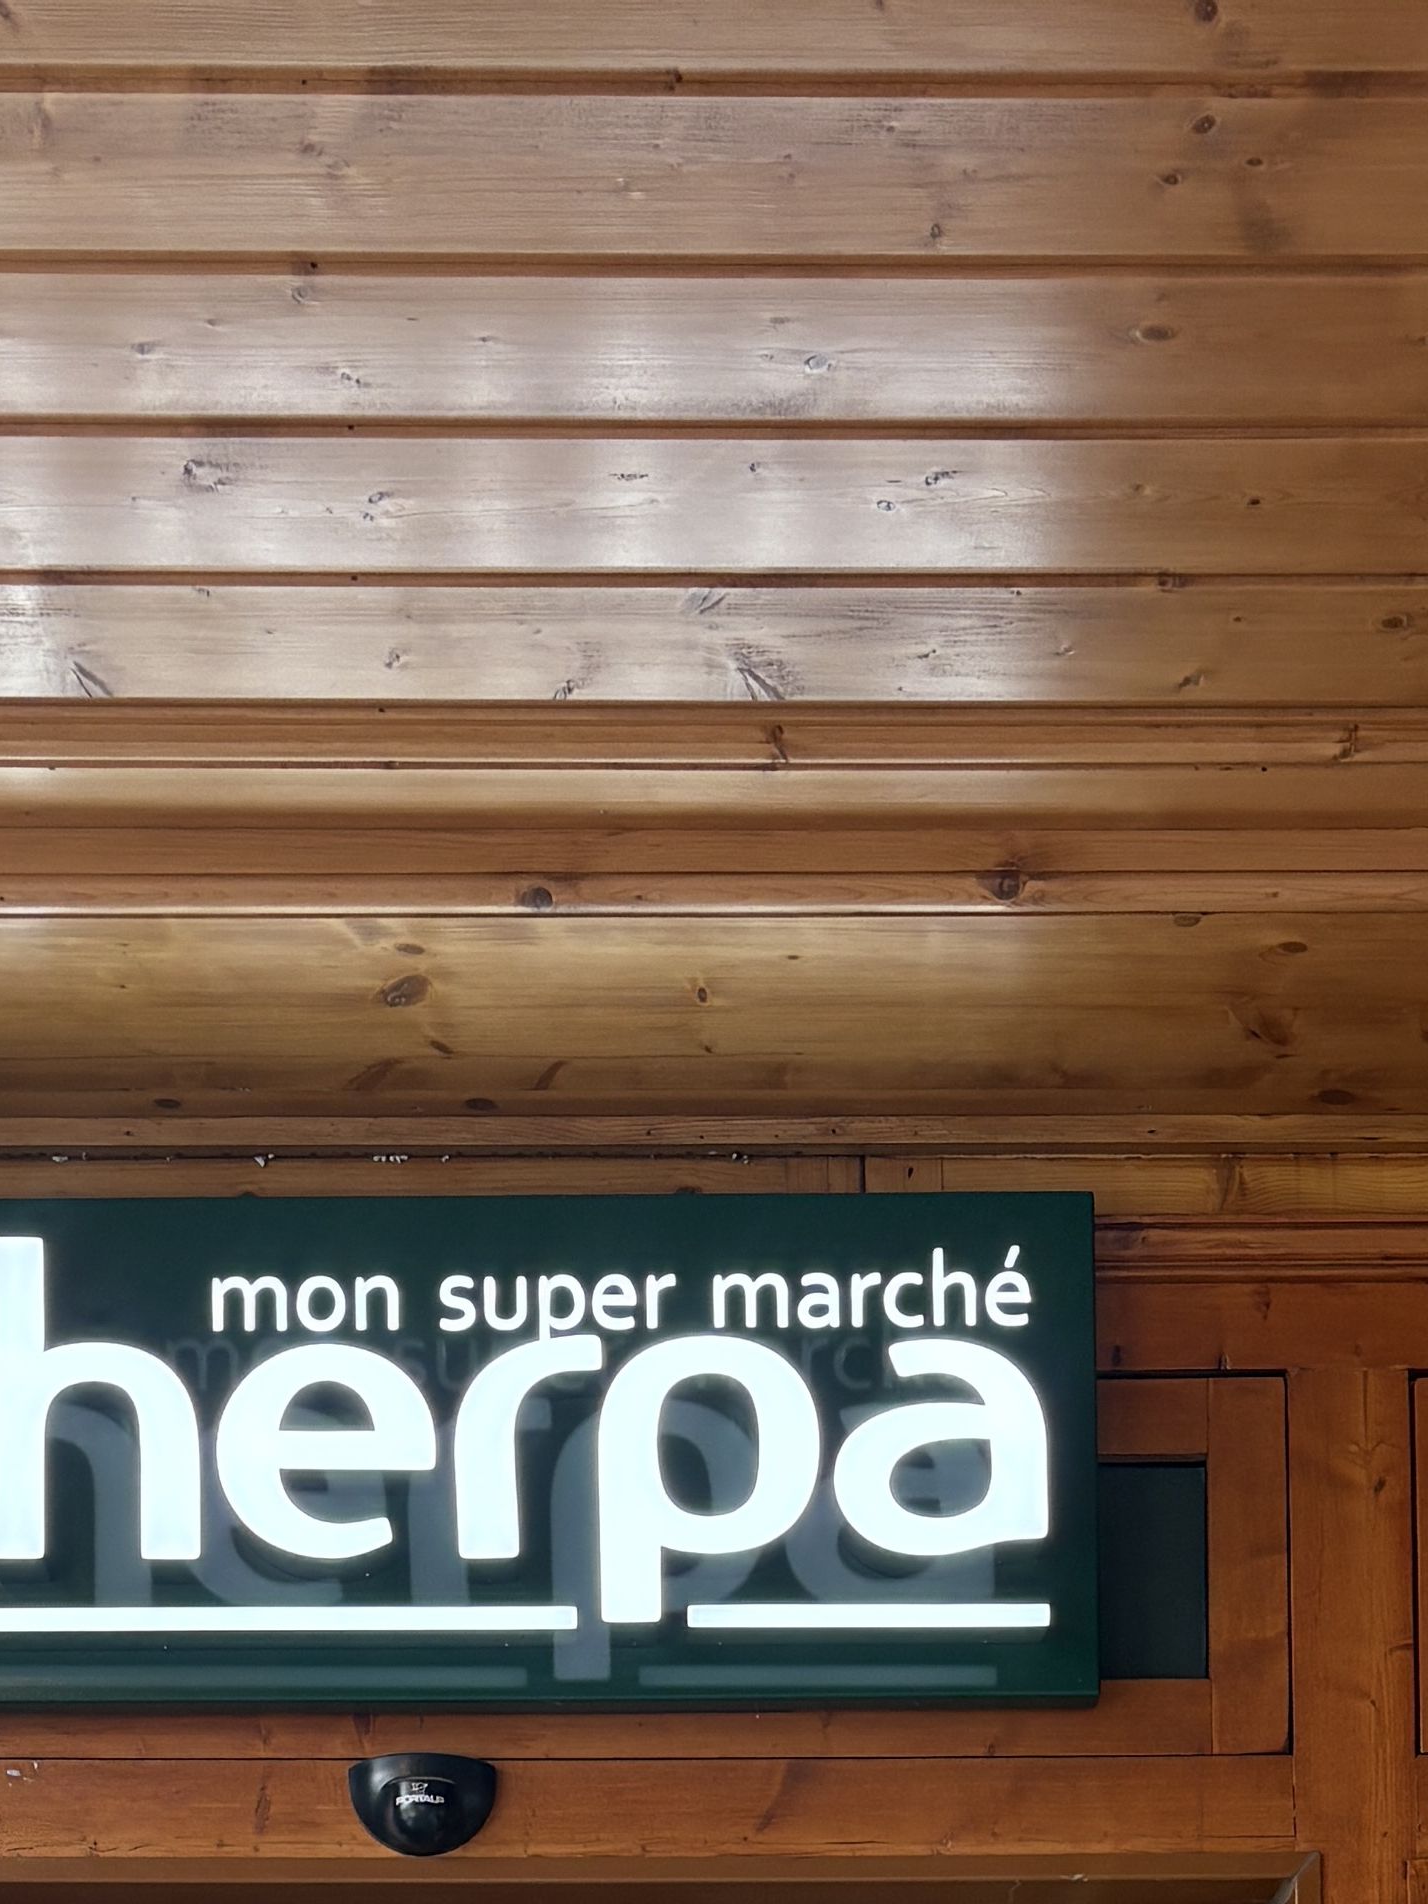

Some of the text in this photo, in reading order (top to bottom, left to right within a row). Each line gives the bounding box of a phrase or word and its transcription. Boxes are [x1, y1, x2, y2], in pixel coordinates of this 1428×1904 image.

[209, 1246, 1032, 1342] mon super marché
